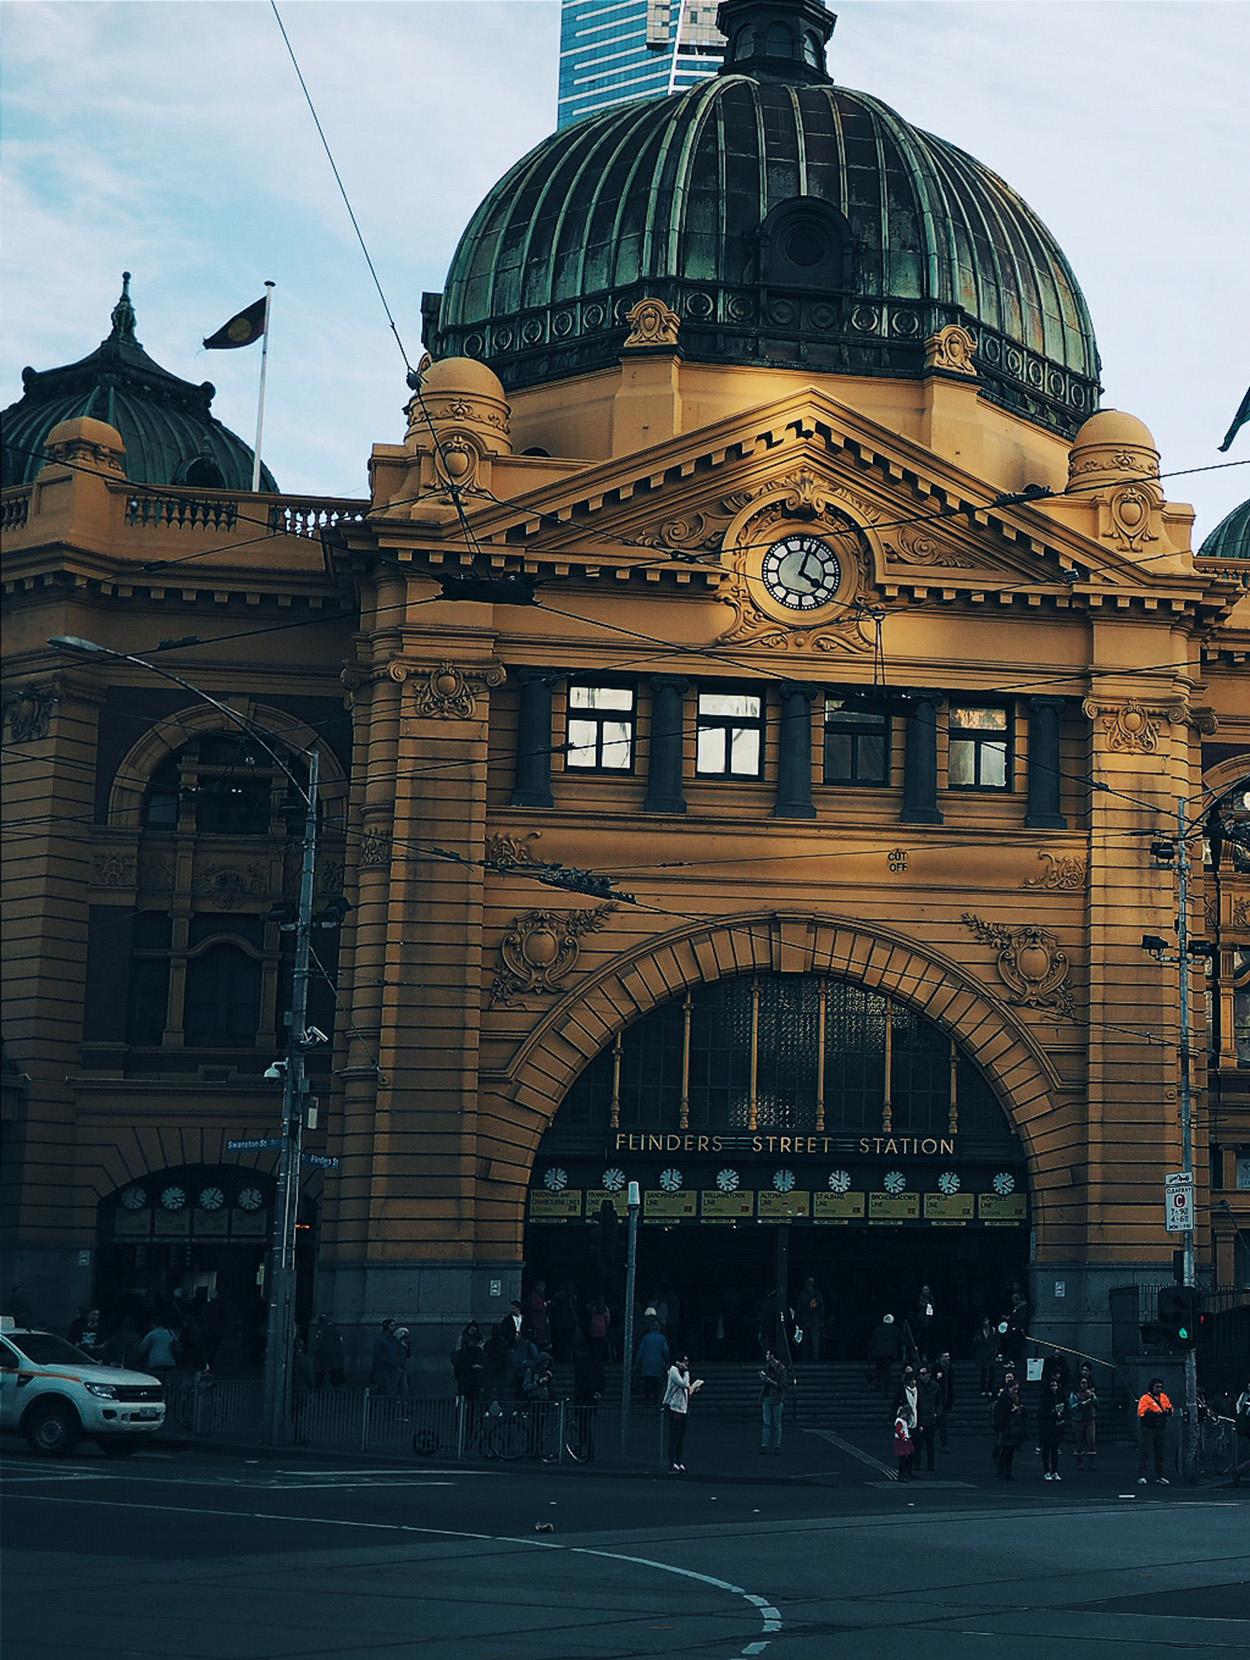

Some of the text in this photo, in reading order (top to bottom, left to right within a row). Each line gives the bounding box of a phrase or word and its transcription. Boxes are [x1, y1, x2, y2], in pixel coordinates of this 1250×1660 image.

[888, 851, 907, 861] CUT
[889, 862, 908, 872] OFF
[227, 1139, 268, 1149] Swanston St
[615, 1133, 955, 1155] FLINDERS STREET STATION
